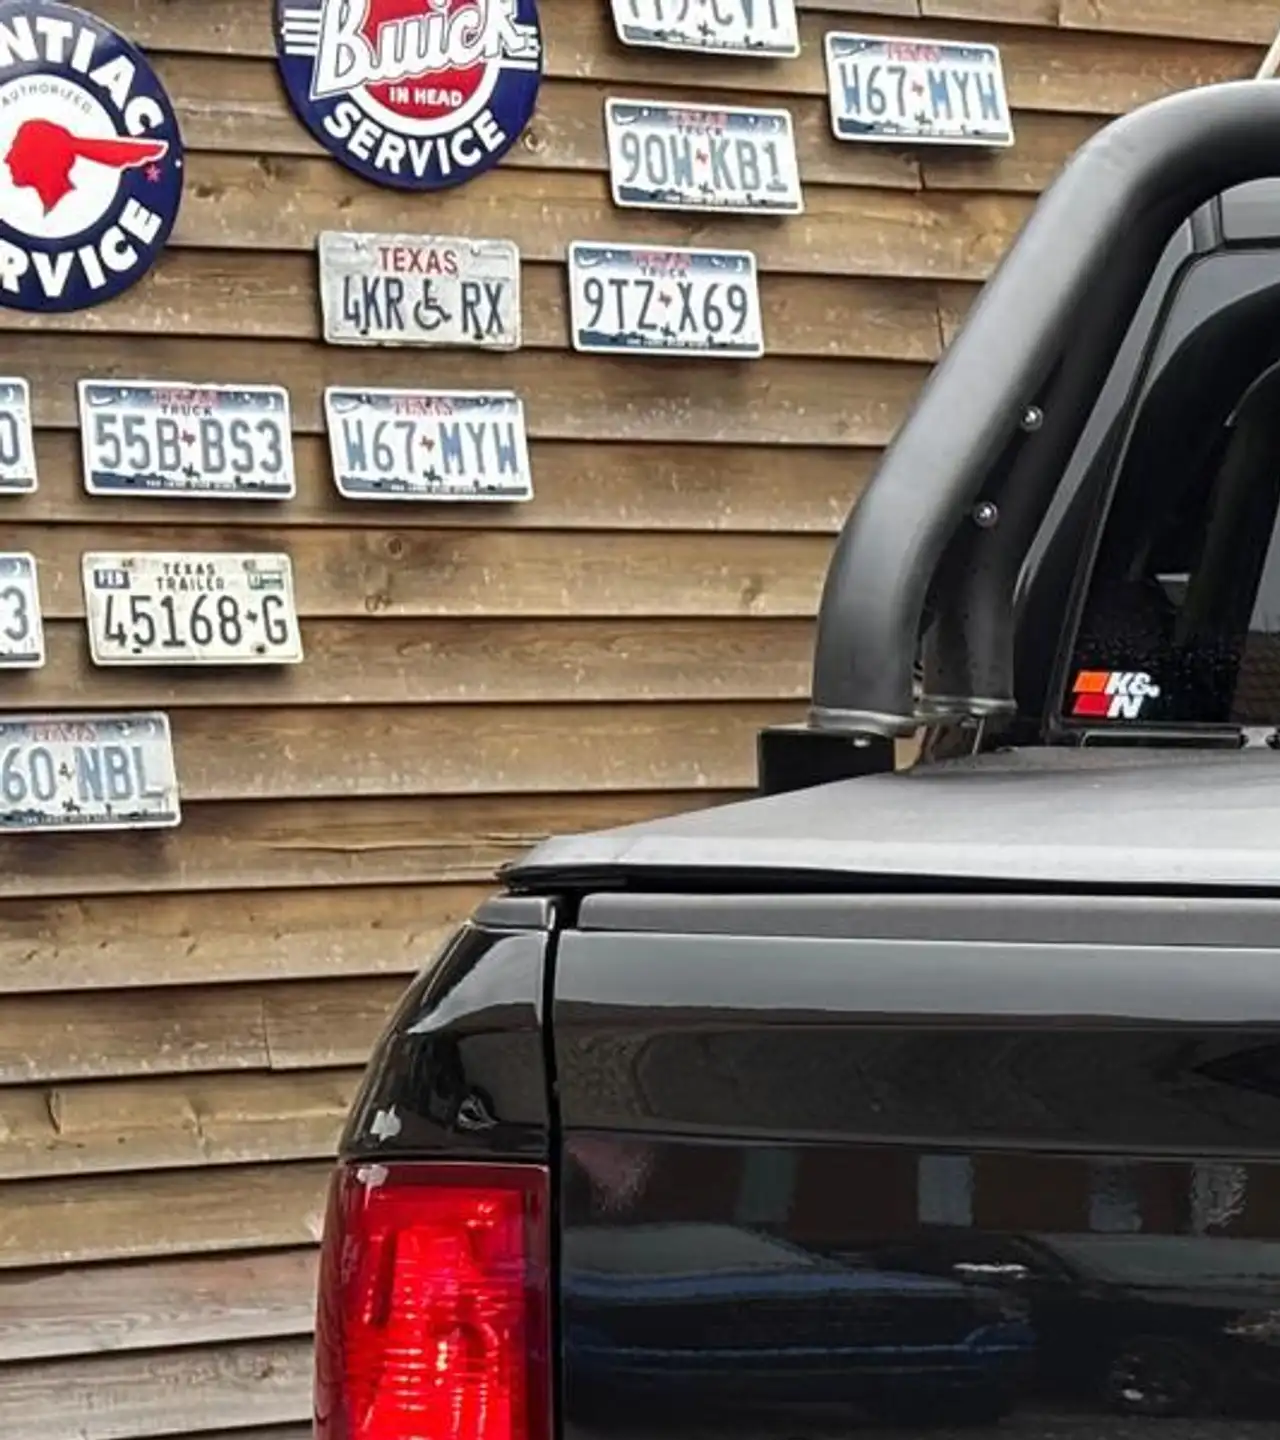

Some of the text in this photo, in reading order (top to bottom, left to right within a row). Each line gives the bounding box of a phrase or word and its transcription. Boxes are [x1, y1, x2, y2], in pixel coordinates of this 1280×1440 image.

[310, 0, 540, 100] Buick
[389, 86, 464, 107] IN HEAD
[839, 62, 1000, 121] W67 MYW
[323, 101, 507, 178] SERVICE
[709, 137, 789, 193] KB1
[378, 246, 459, 276] TEXAS
[342, 274, 505, 336] 4KR RX
[583, 275, 748, 335] 9TZ X69
[160, 403, 213, 417] TRUCK
[94, 412, 284, 474] 55B BS3
[341, 417, 519, 475] W67 MYW
[156, 576, 226, 593] TRAILER
[162, 562, 216, 576] TEXAS
[103, 593, 289, 648] 45168 G
[72, 745, 168, 802] NBL
